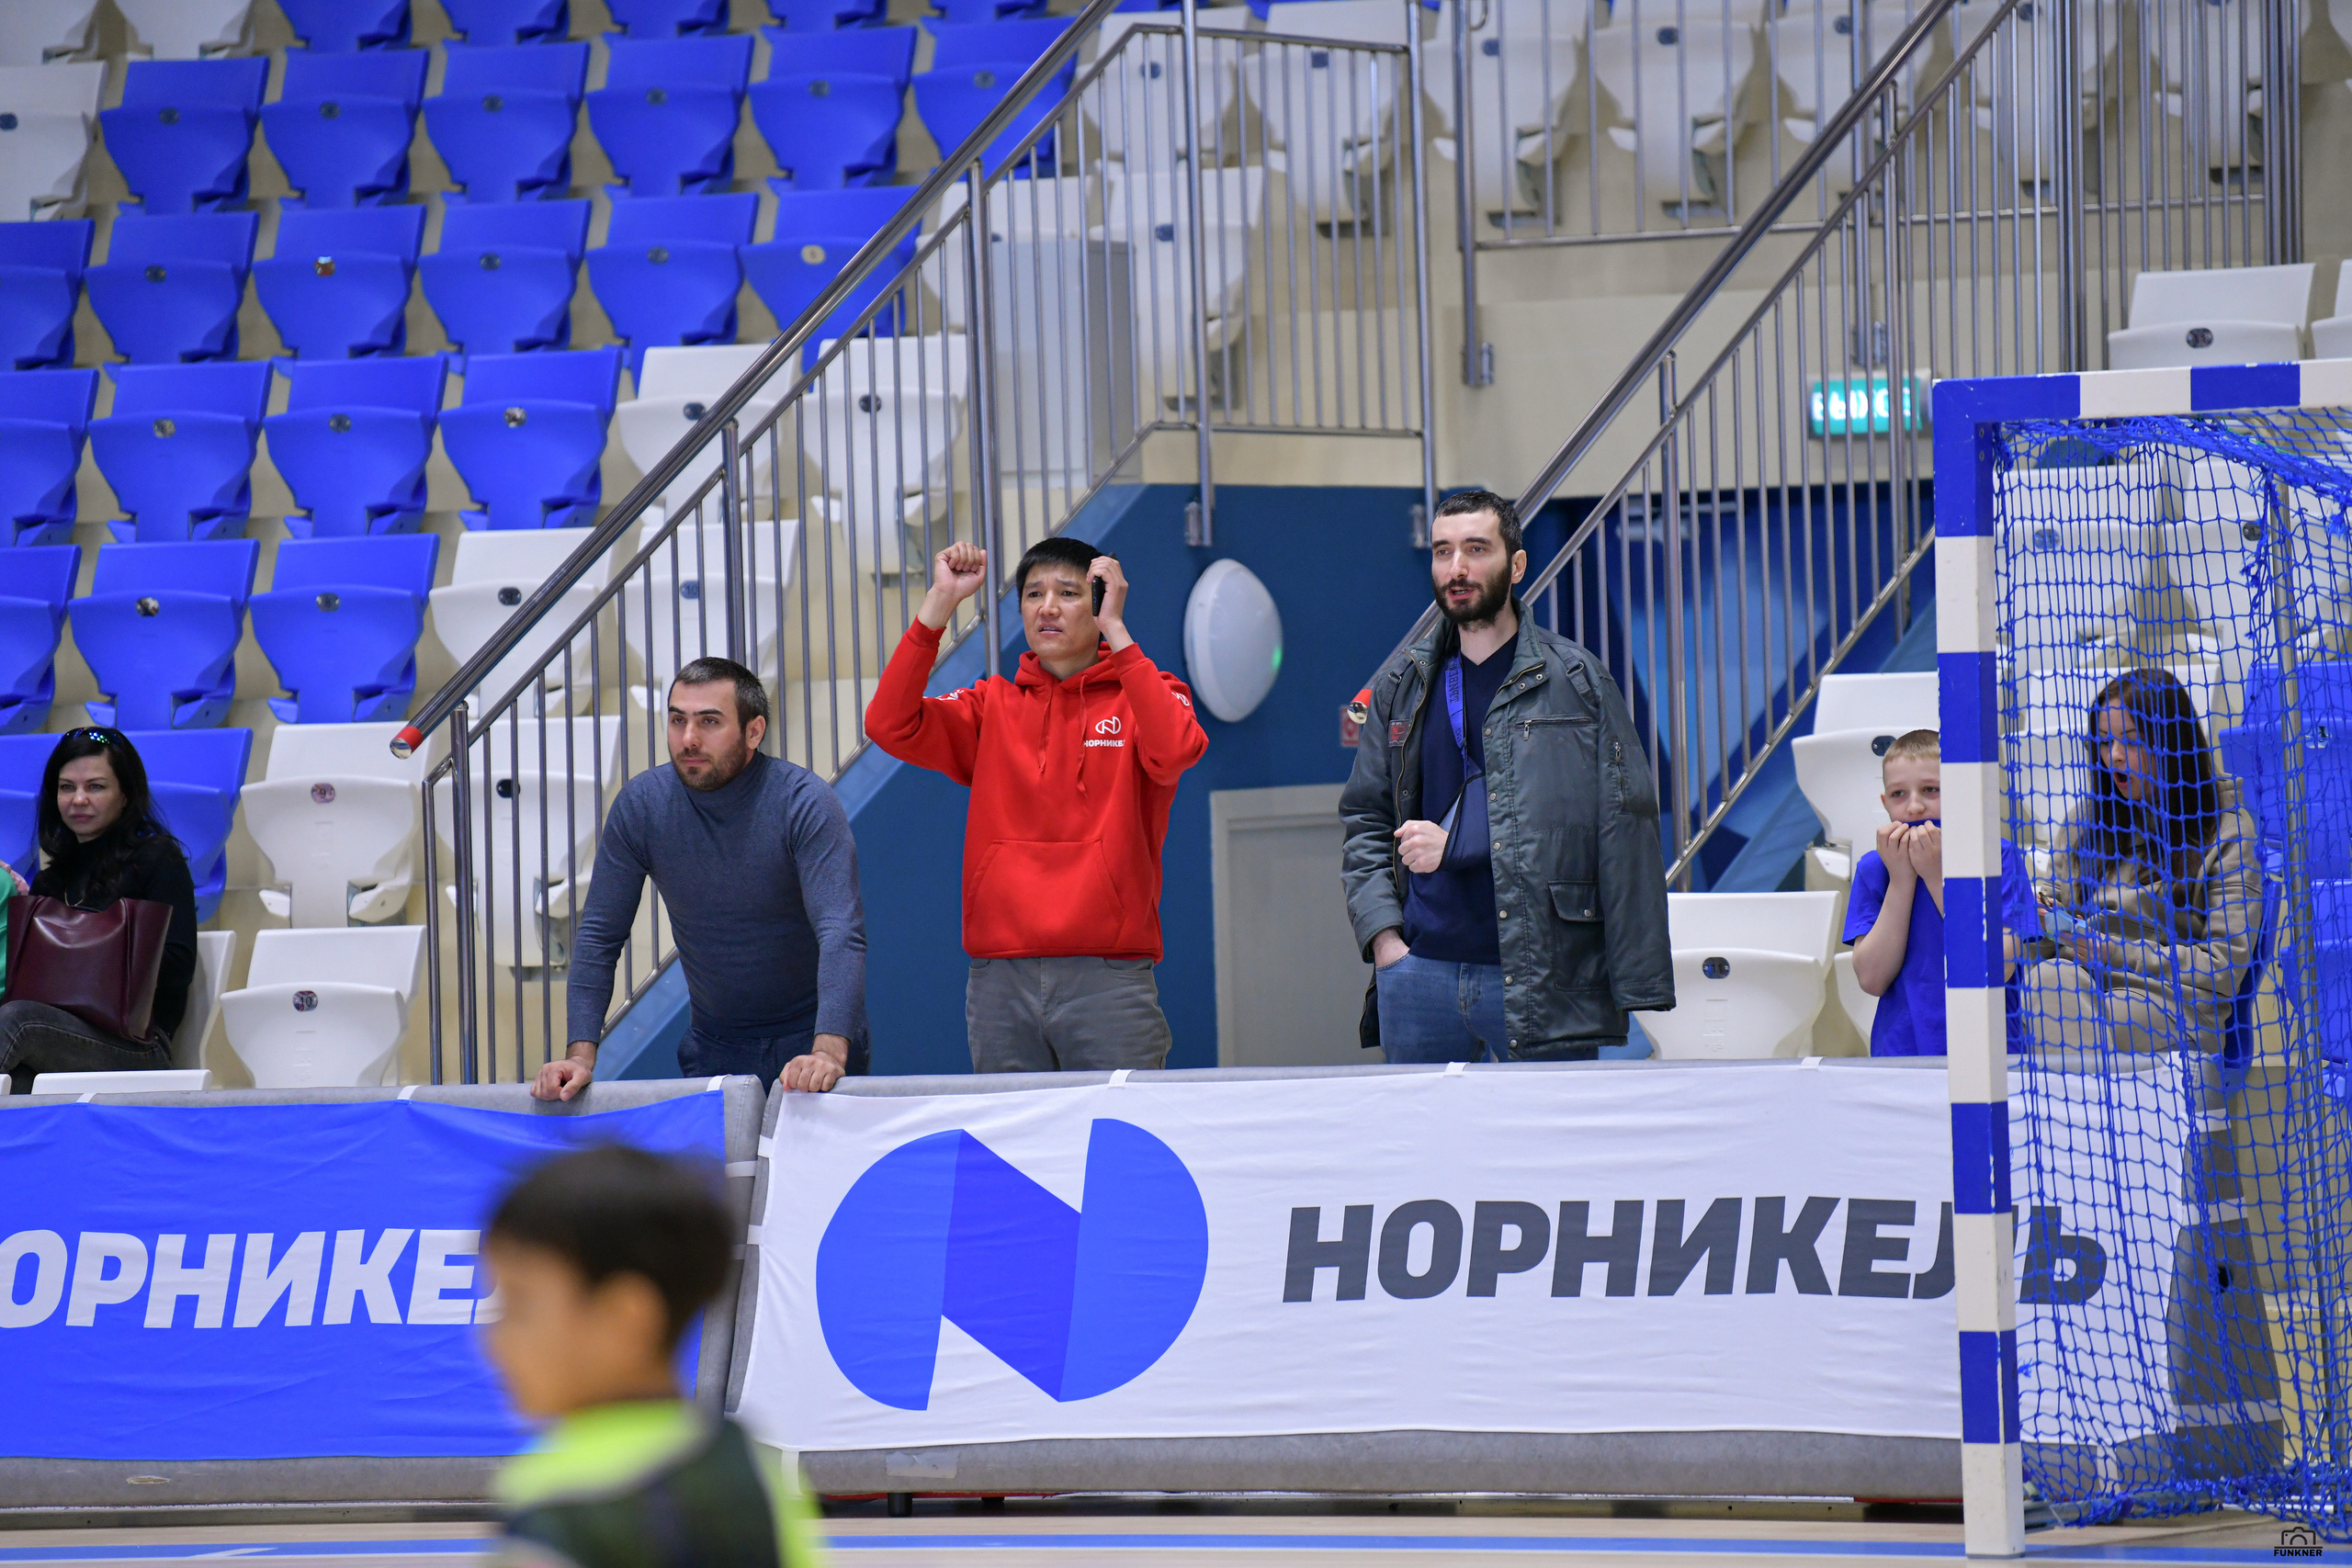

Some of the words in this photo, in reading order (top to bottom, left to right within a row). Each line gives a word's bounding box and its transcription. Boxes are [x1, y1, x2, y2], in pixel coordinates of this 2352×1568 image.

[1084, 739, 1125, 748] НОРНИКЕ
[319, 787, 327, 800] 9
[1712, 964, 1724, 976] 11
[300, 996, 313, 1009] 10
[0, 1228, 502, 1329] ОРНИКЕ
